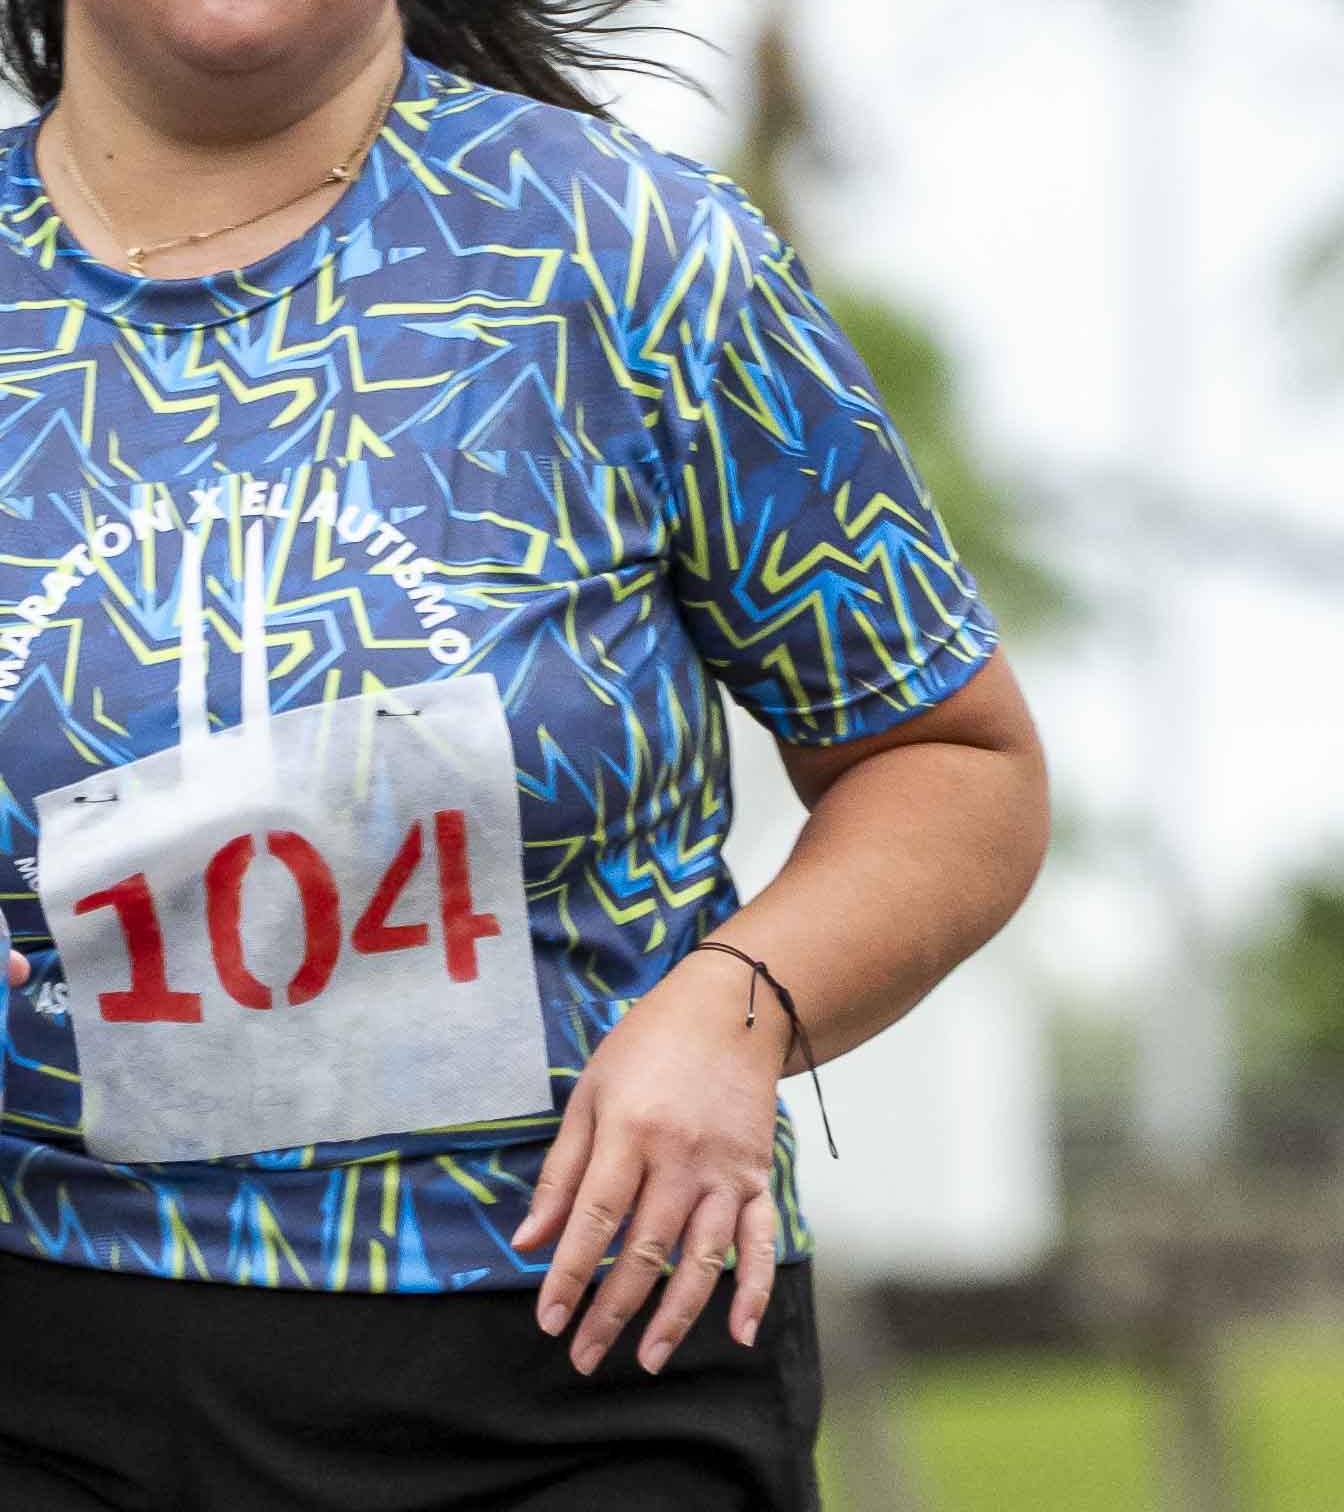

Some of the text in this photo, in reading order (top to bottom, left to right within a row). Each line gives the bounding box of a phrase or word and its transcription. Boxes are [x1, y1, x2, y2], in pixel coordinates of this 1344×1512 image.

[187, 487, 225, 524] X
[239, 480, 292, 519] EL
[300, 489, 471, 665] AUTISMO
[74, 809, 502, 1024] 104
